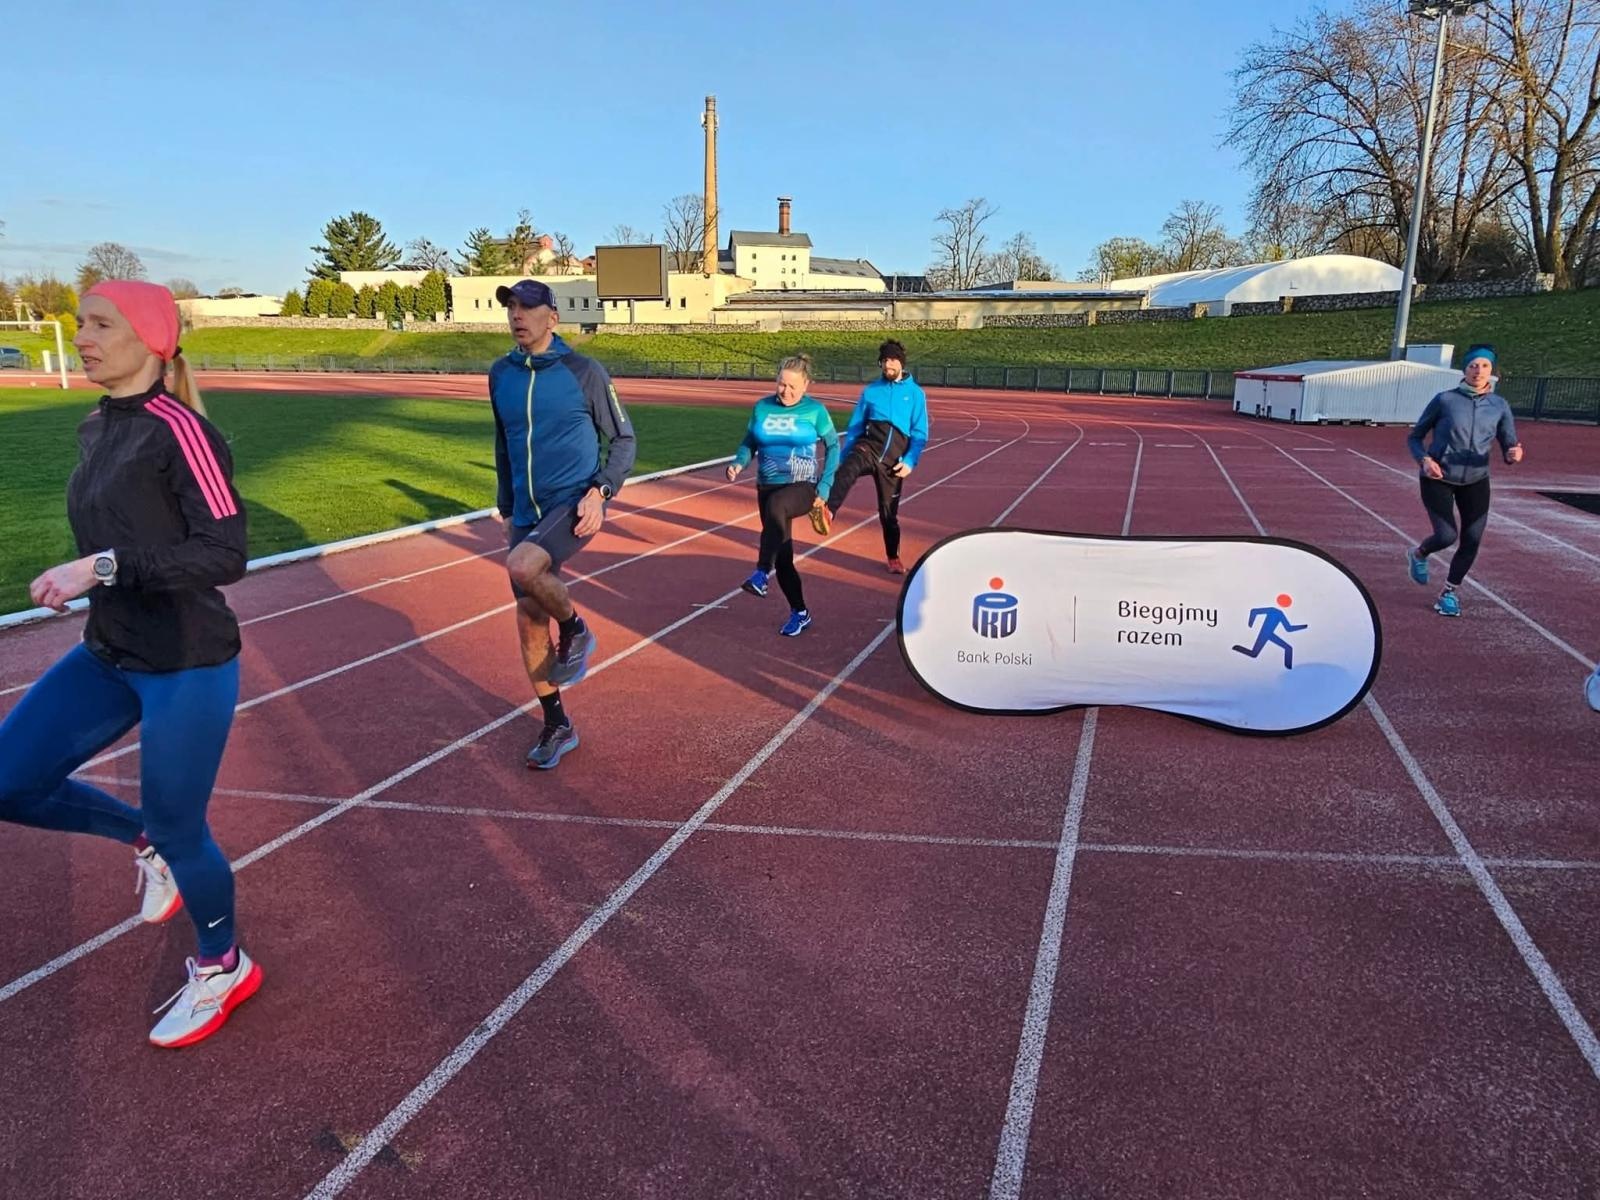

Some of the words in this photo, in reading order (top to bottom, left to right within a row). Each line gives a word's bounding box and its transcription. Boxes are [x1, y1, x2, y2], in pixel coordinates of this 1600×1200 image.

[972, 592, 1019, 639] PKO
[1118, 600, 1218, 628] Biegajmy
[1117, 630, 1182, 646] razem
[957, 650, 990, 664] Bank
[994, 651, 1033, 667] Polski
